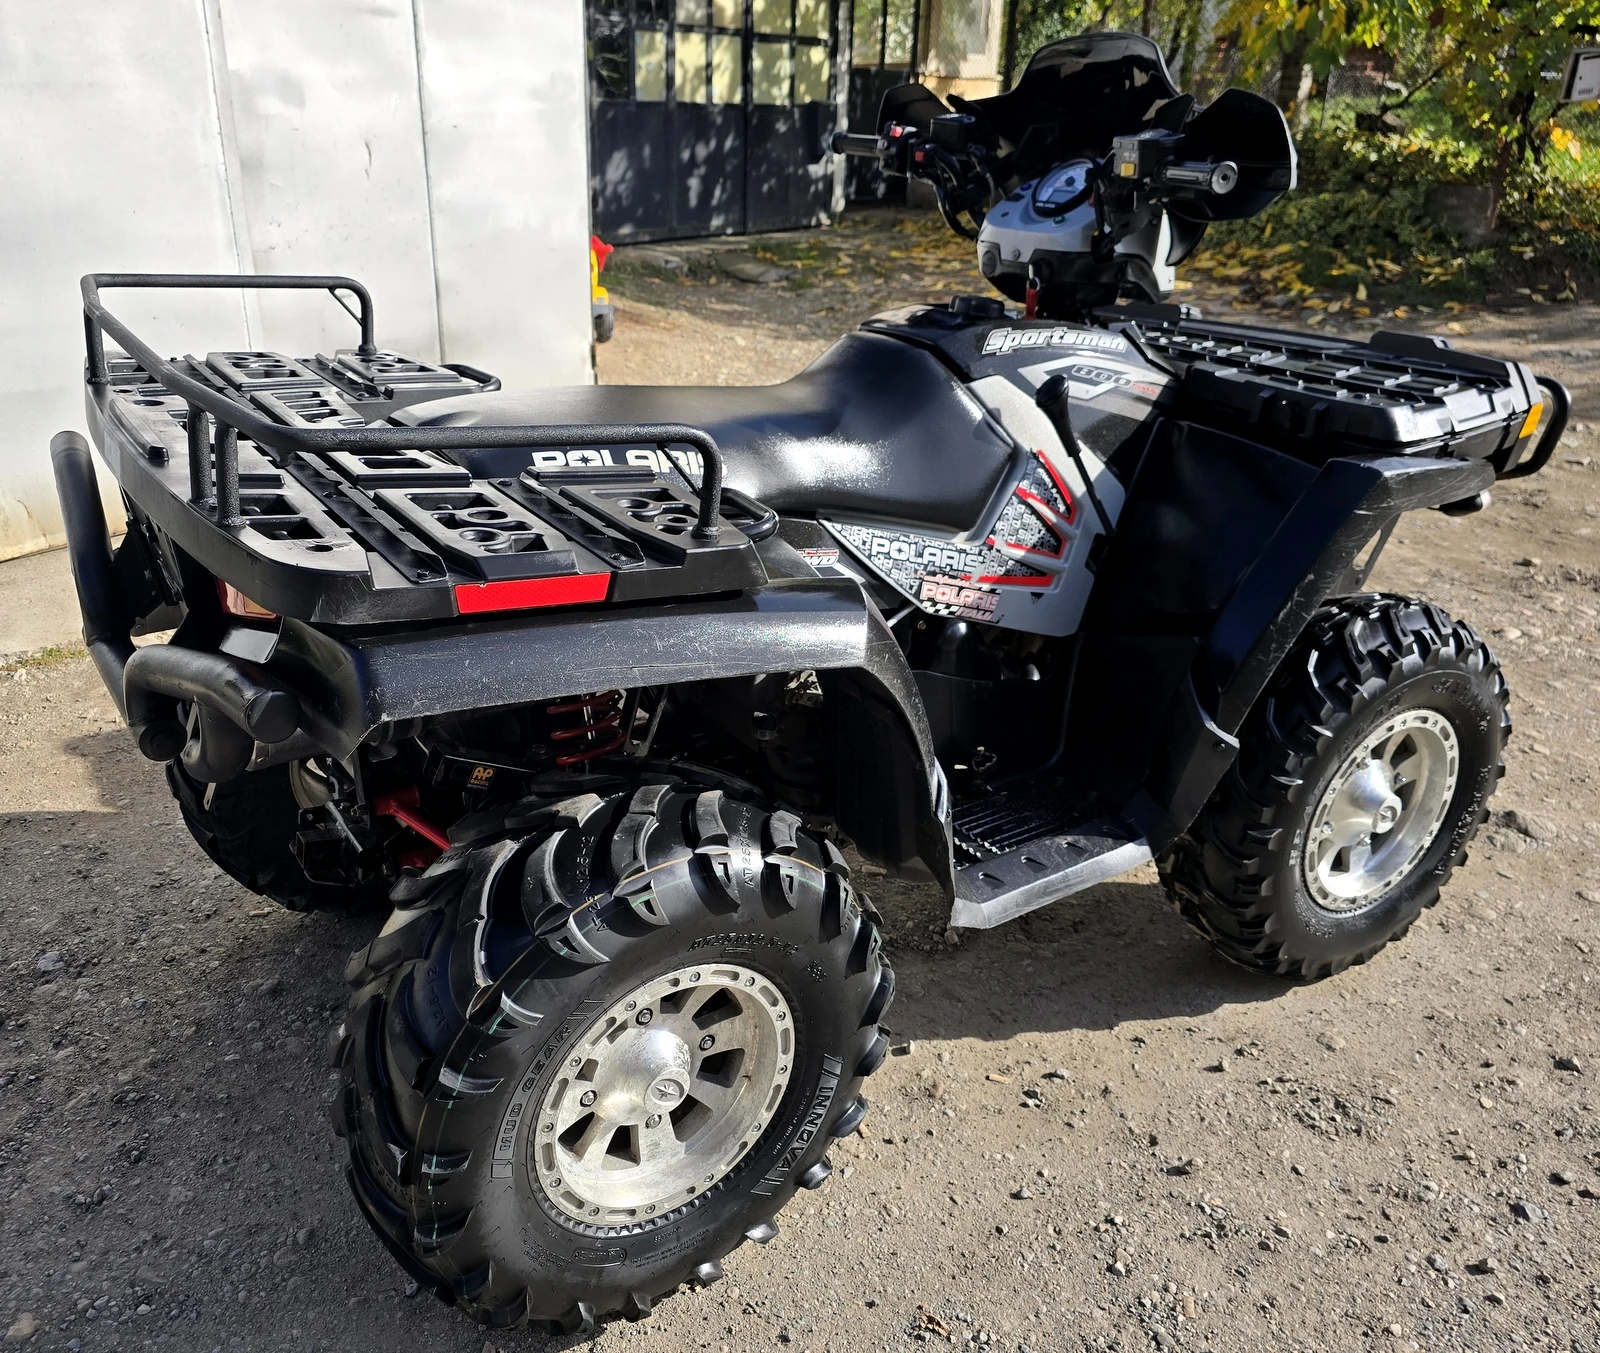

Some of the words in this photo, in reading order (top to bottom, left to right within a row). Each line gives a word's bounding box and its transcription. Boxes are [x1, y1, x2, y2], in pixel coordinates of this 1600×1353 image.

[983, 327, 1127, 355] Sportsman
[871, 537, 984, 572] POLARIS
[499, 1102, 523, 1152] MUD
[521, 1024, 572, 1093] GEAR
[775, 1086, 835, 1171] INNOVA
